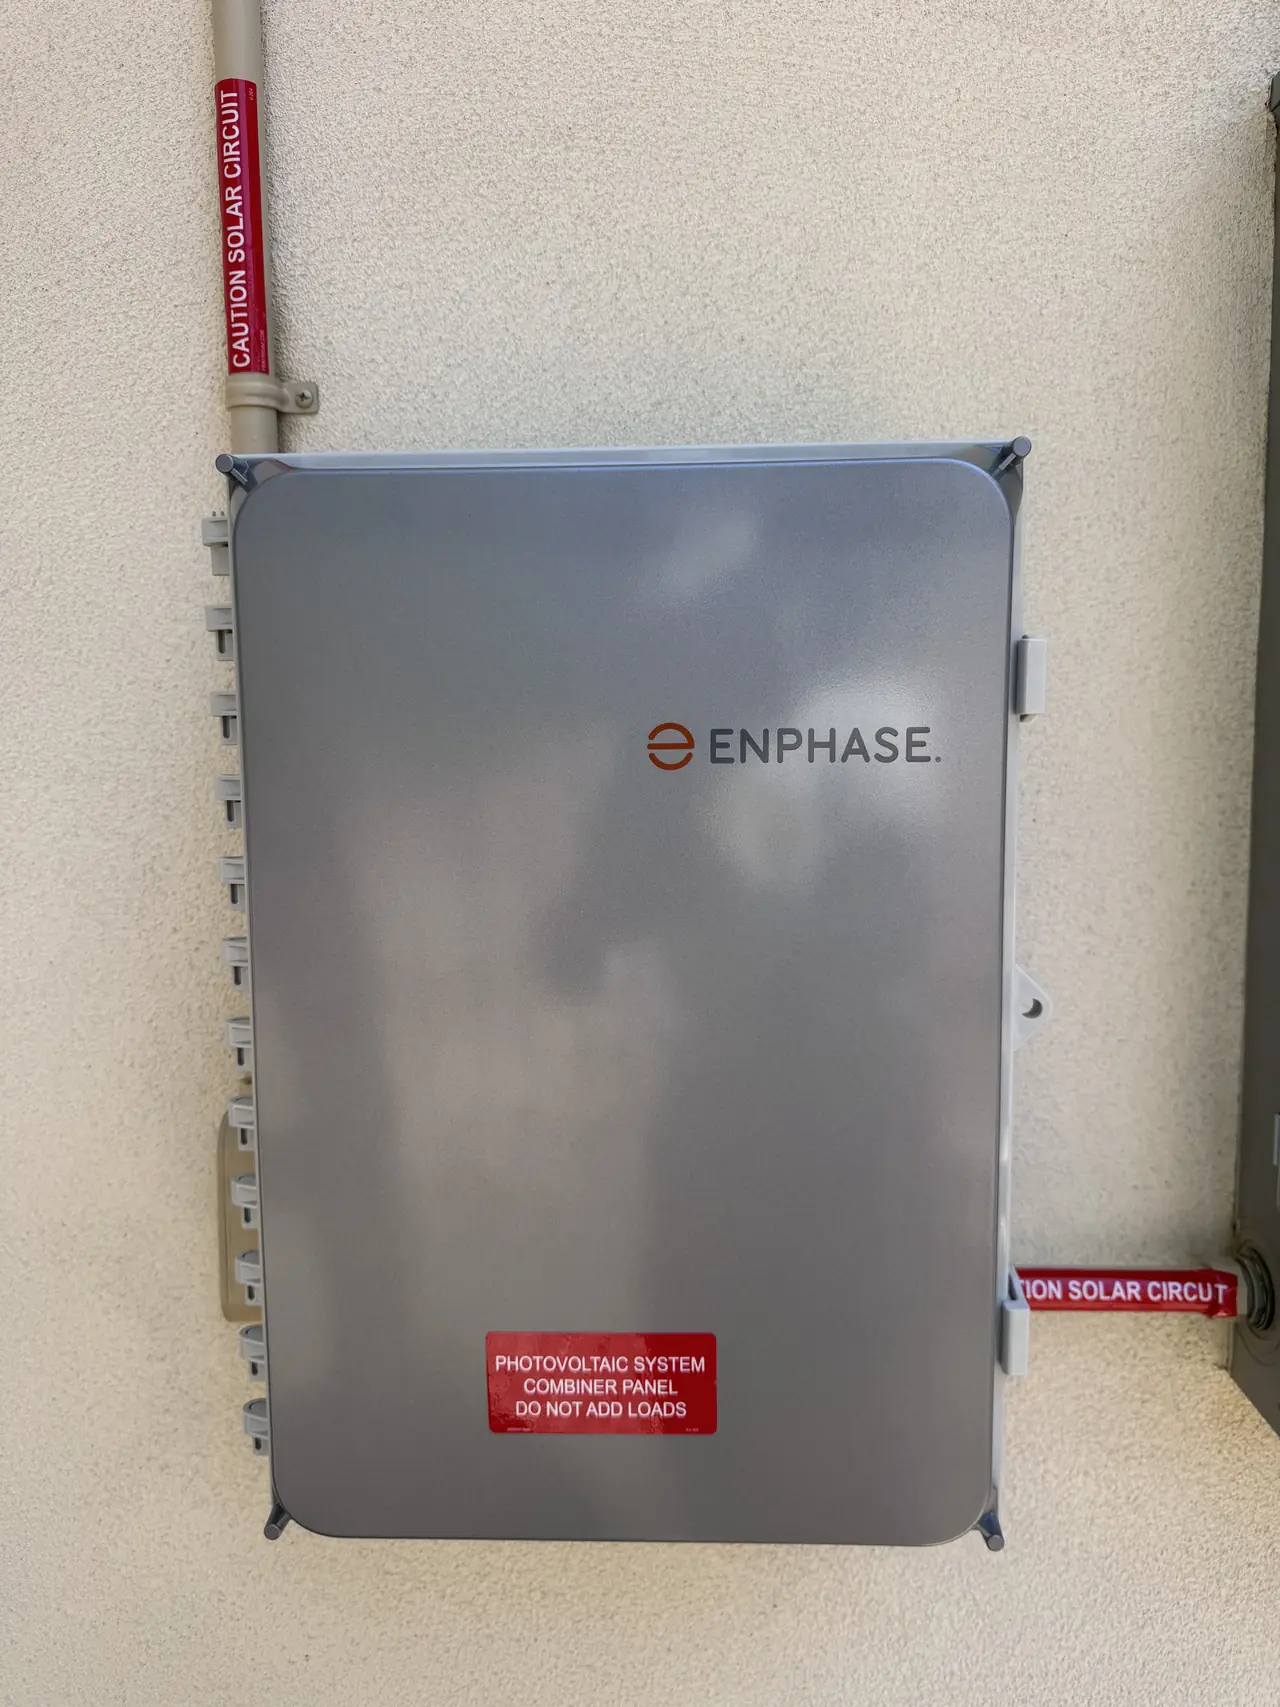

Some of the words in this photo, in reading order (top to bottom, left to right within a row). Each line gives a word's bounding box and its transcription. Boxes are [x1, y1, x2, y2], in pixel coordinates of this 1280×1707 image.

[220, 90, 242, 179] CIRCUIT
[225, 184, 246, 263] SOLAR
[228, 270, 251, 367] CAUTION
[1068, 1280, 1141, 1302] SOLAR
[495, 1355, 629, 1373] PHOTOVOLTAIC
[633, 1355, 706, 1373] SYSTEM
[523, 1378, 617, 1395] COMBINER
[622, 1378, 679, 1396] PANEL
[515, 1400, 542, 1417] DO
[546, 1400, 583, 1417] NOT
[586, 1401, 623, 1417] ADD
[628, 1401, 687, 1418] LOADS
